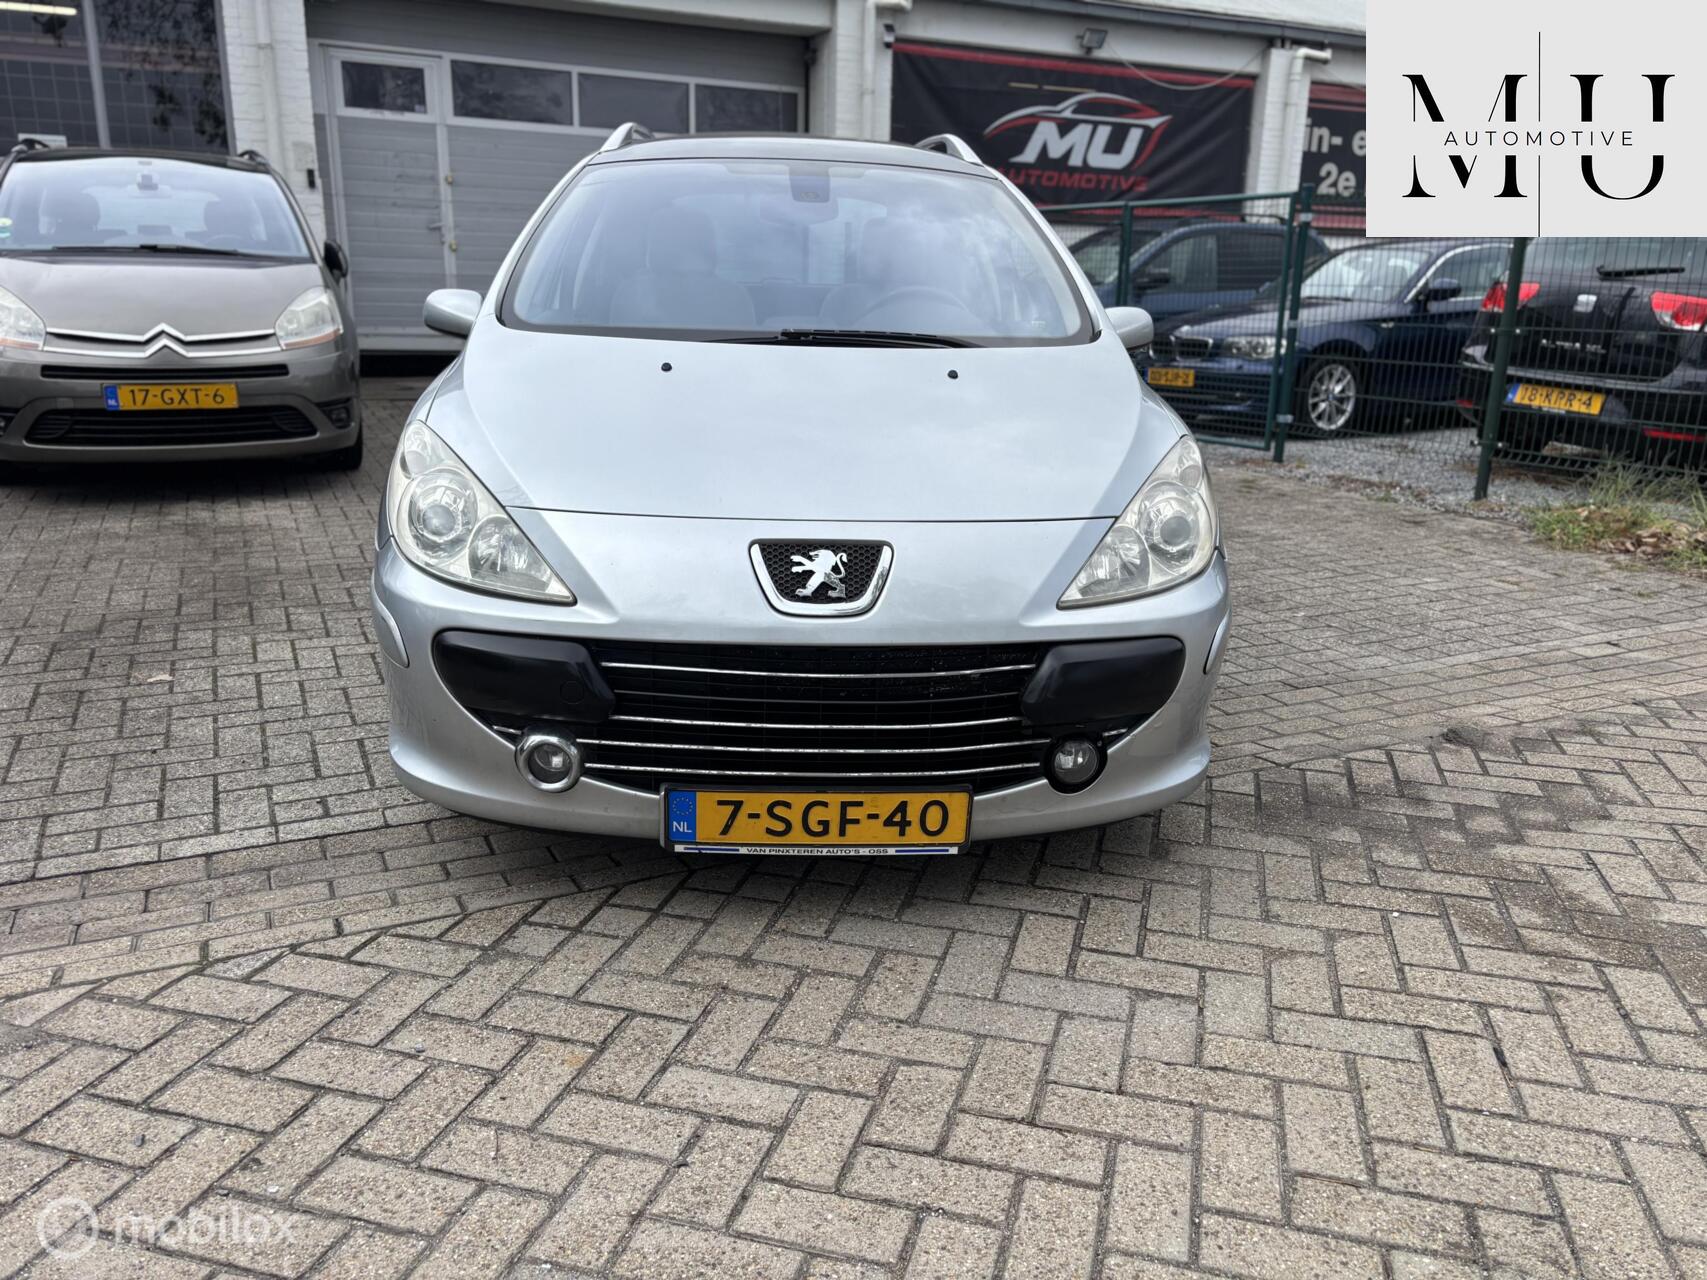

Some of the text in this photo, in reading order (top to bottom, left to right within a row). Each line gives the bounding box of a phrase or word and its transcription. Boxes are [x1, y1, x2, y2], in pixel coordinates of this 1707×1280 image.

[1009, 121, 1144, 170] MU
[1316, 161, 1357, 197] 2e
[129, 388, 225, 406] 17-GXT-6
[1519, 386, 1593, 409] 18-KPR-4
[673, 799, 950, 838] NL 7-SGF-40
